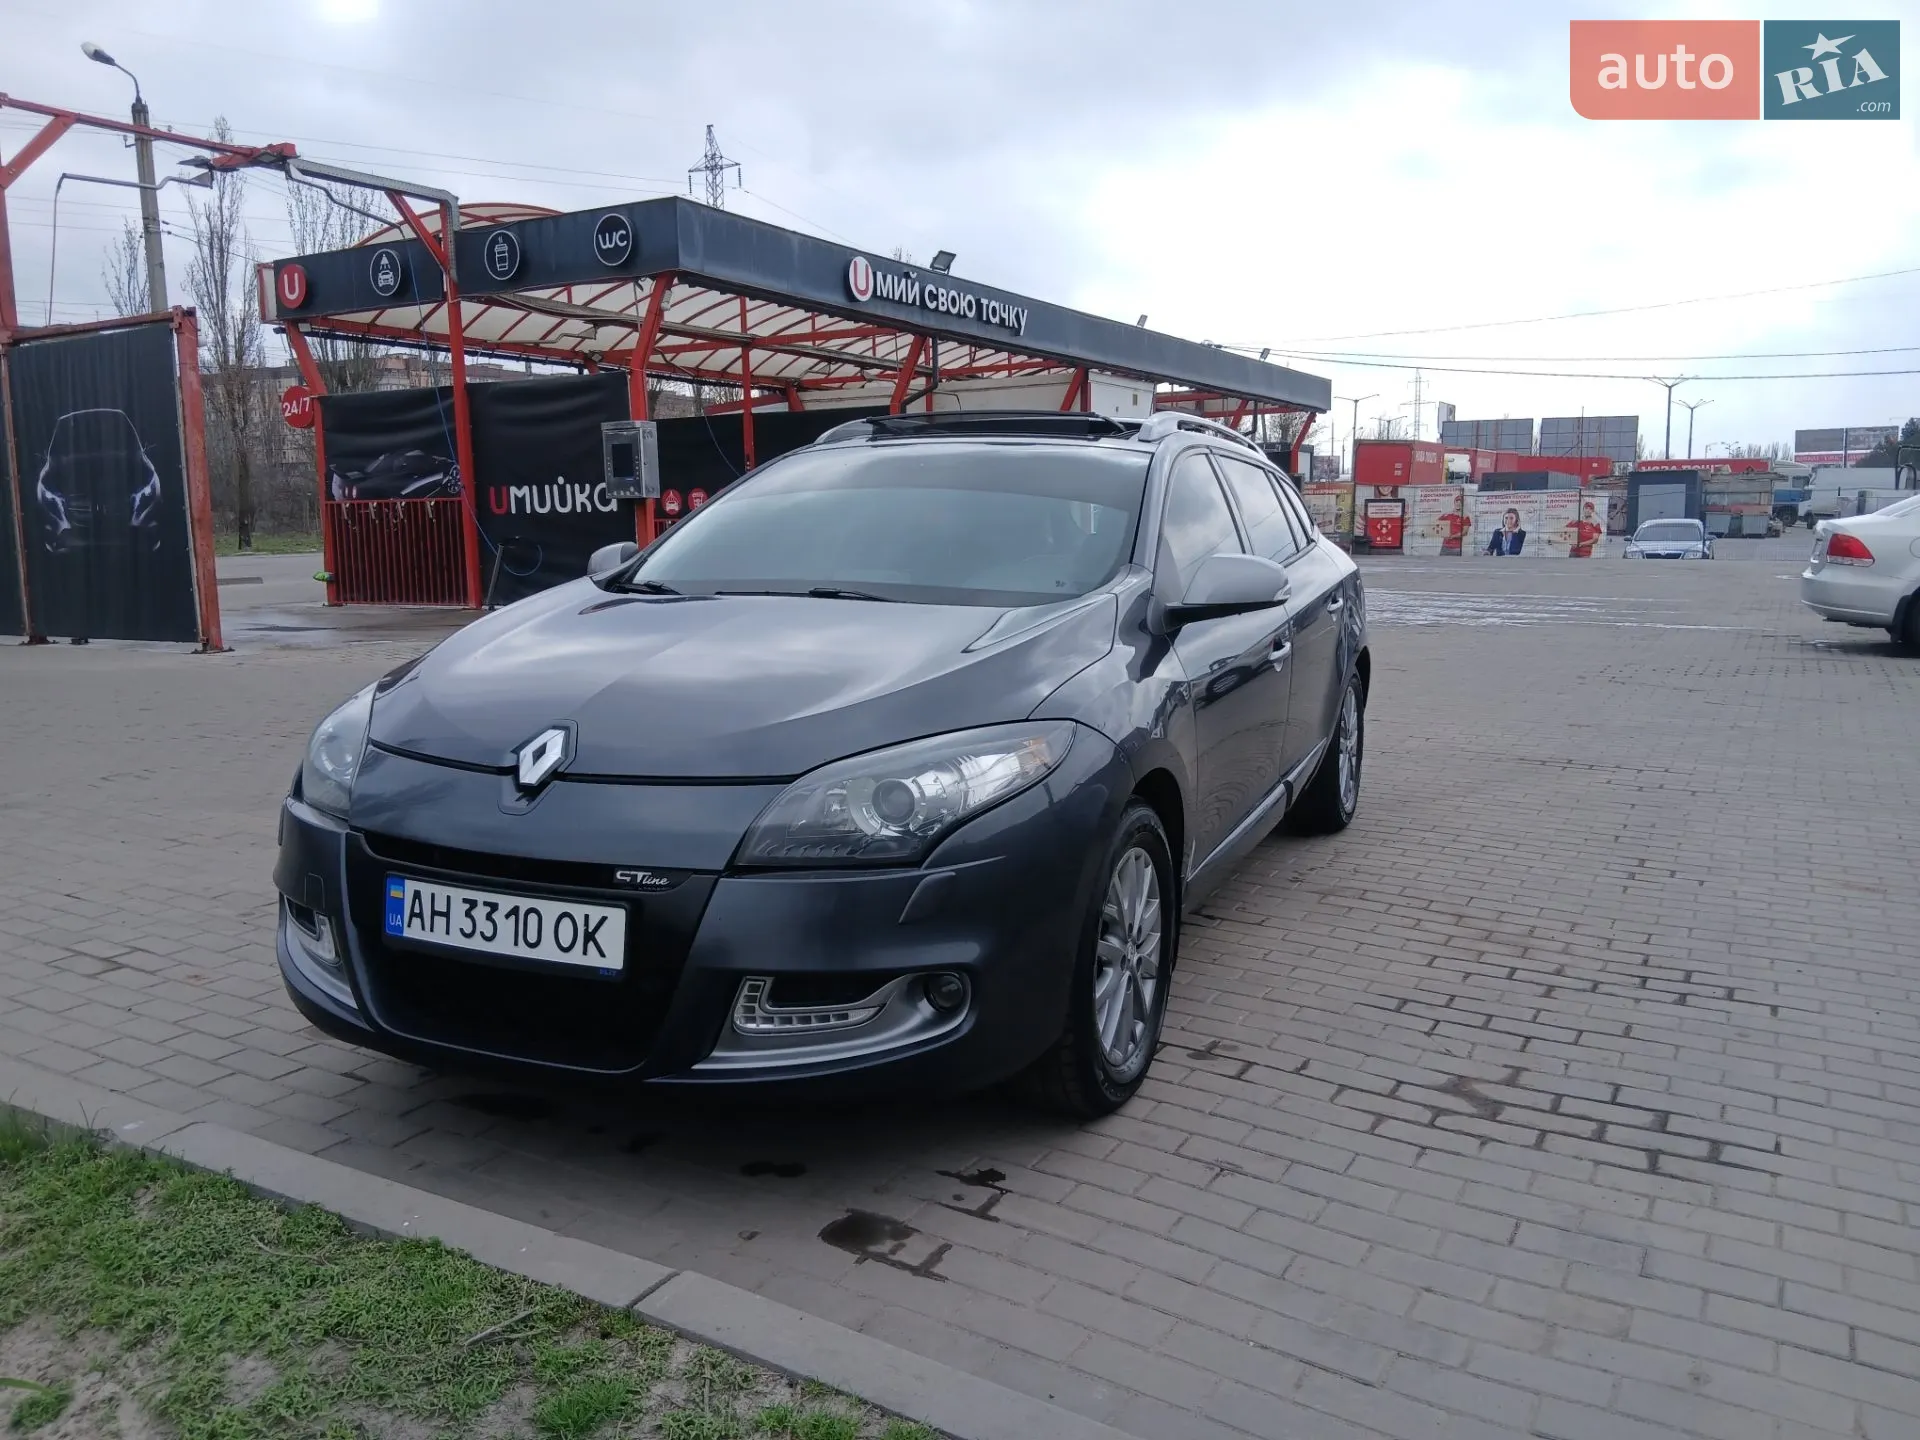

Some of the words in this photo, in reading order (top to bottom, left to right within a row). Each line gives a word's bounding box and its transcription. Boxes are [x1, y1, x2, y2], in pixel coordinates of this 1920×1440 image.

[598, 229, 628, 250] WC
[876, 271, 920, 306] МИЙ
[924, 284, 977, 319] СВОЮ
[282, 395, 310, 418] 24/7
[389, 913, 402, 927] UA
[407, 889, 451, 936] AH
[458, 898, 543, 950] 3310
[553, 911, 609, 959] OK
